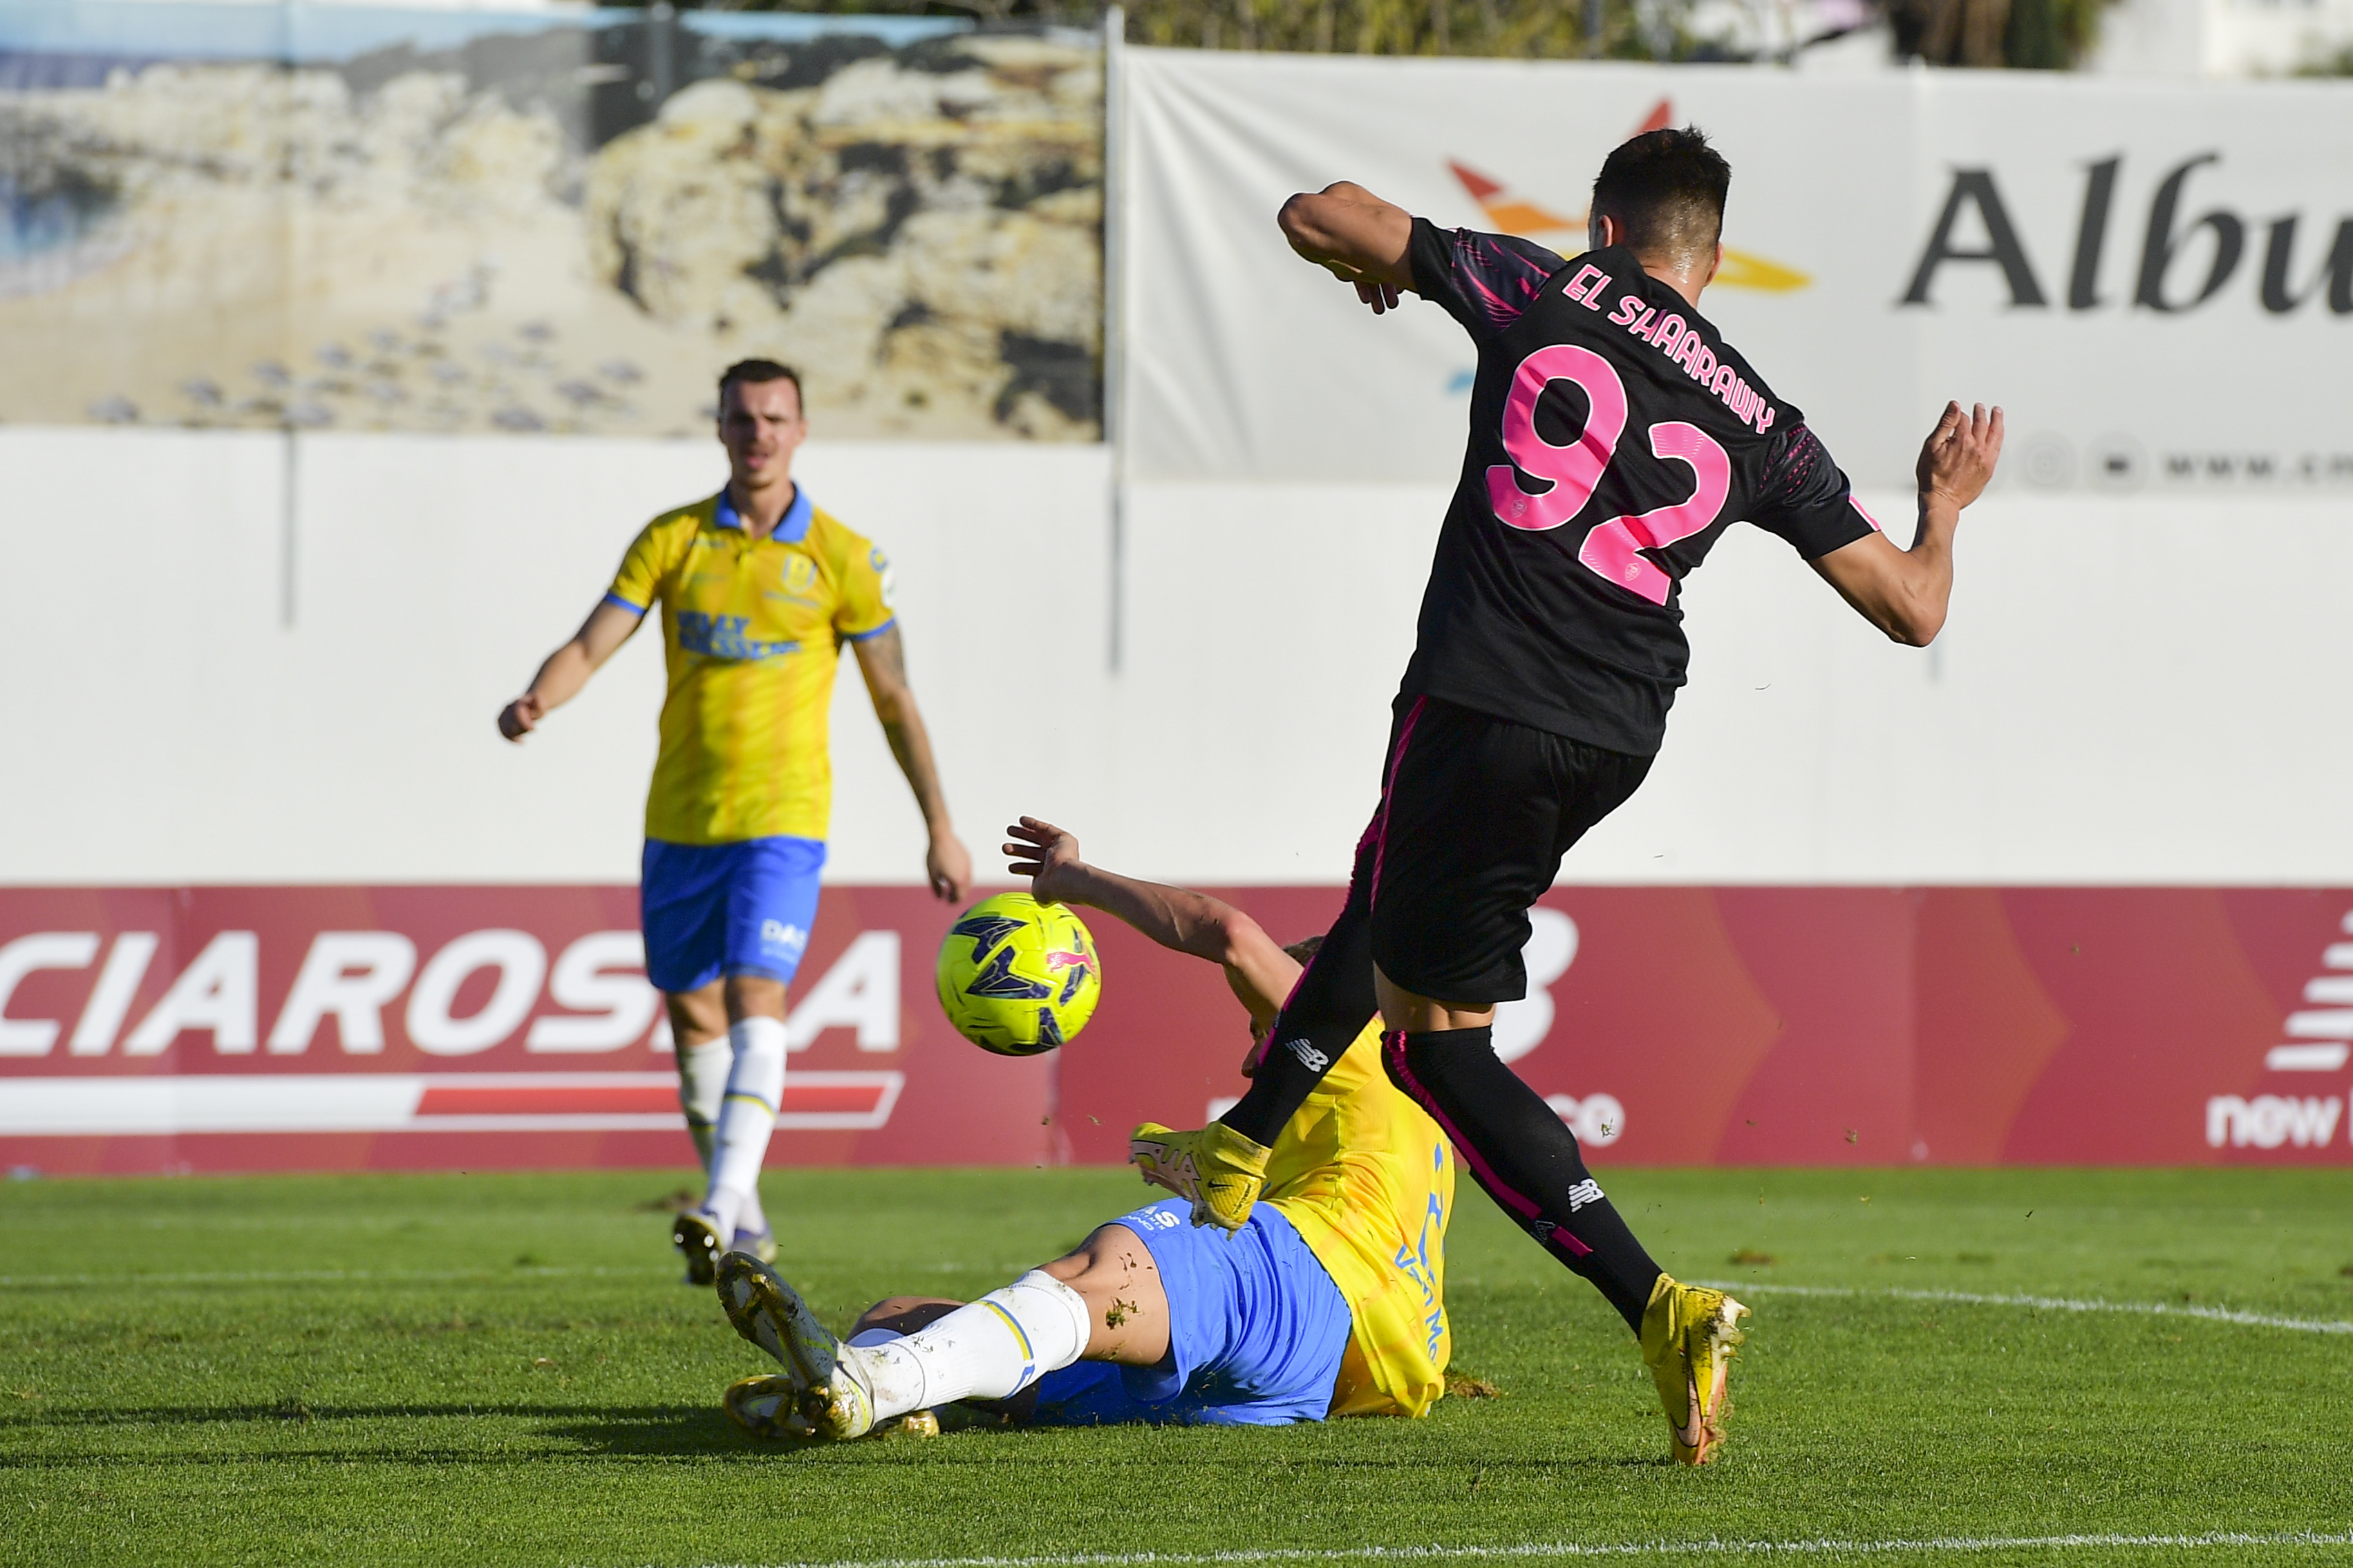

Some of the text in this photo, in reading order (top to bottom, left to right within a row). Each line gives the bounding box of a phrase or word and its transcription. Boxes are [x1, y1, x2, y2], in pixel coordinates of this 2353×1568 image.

[1562, 263, 1775, 435] EL SHAARAWY
[1485, 344, 1731, 607] 92
[0, 929, 901, 1056] CIAROSA
